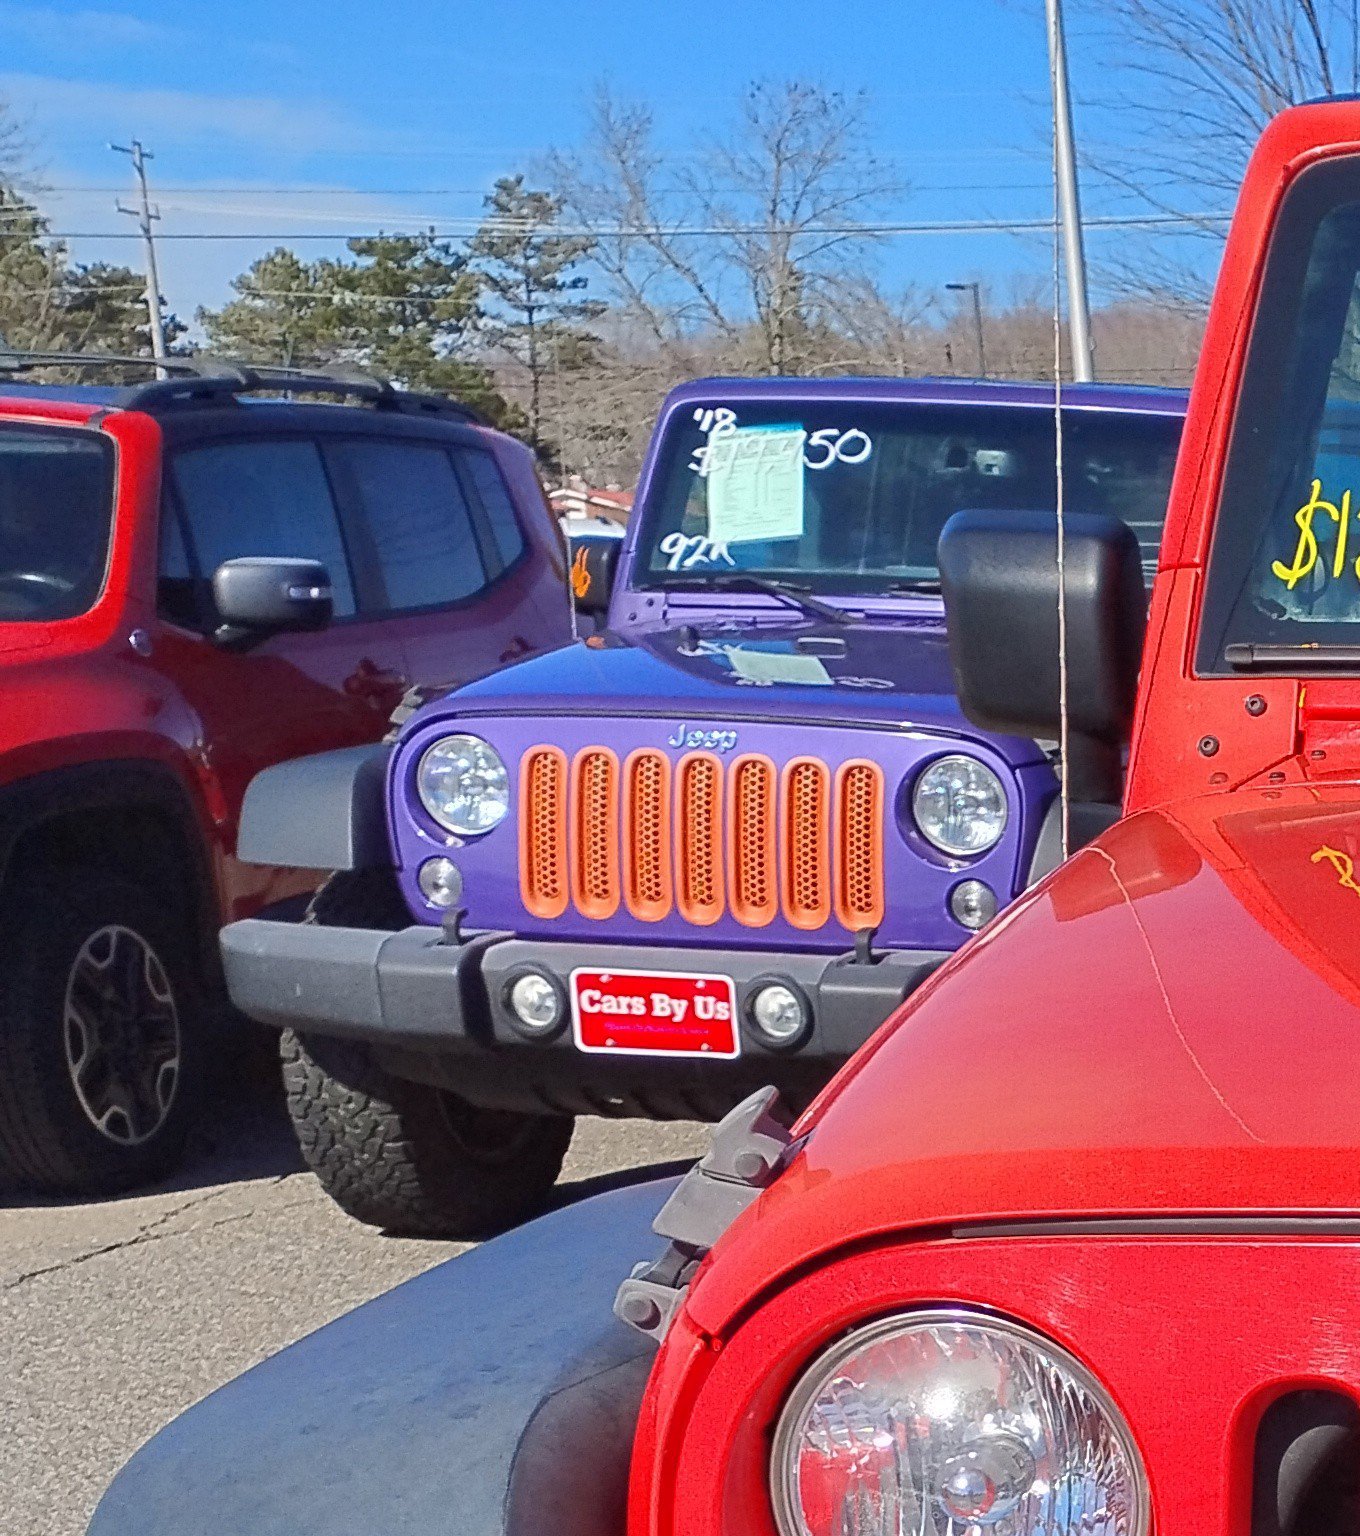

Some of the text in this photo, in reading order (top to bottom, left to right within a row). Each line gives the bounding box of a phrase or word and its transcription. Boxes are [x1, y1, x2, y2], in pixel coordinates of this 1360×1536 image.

[668, 723, 737, 754] Jeep
[580, 989, 729, 1022] Cars By Us
